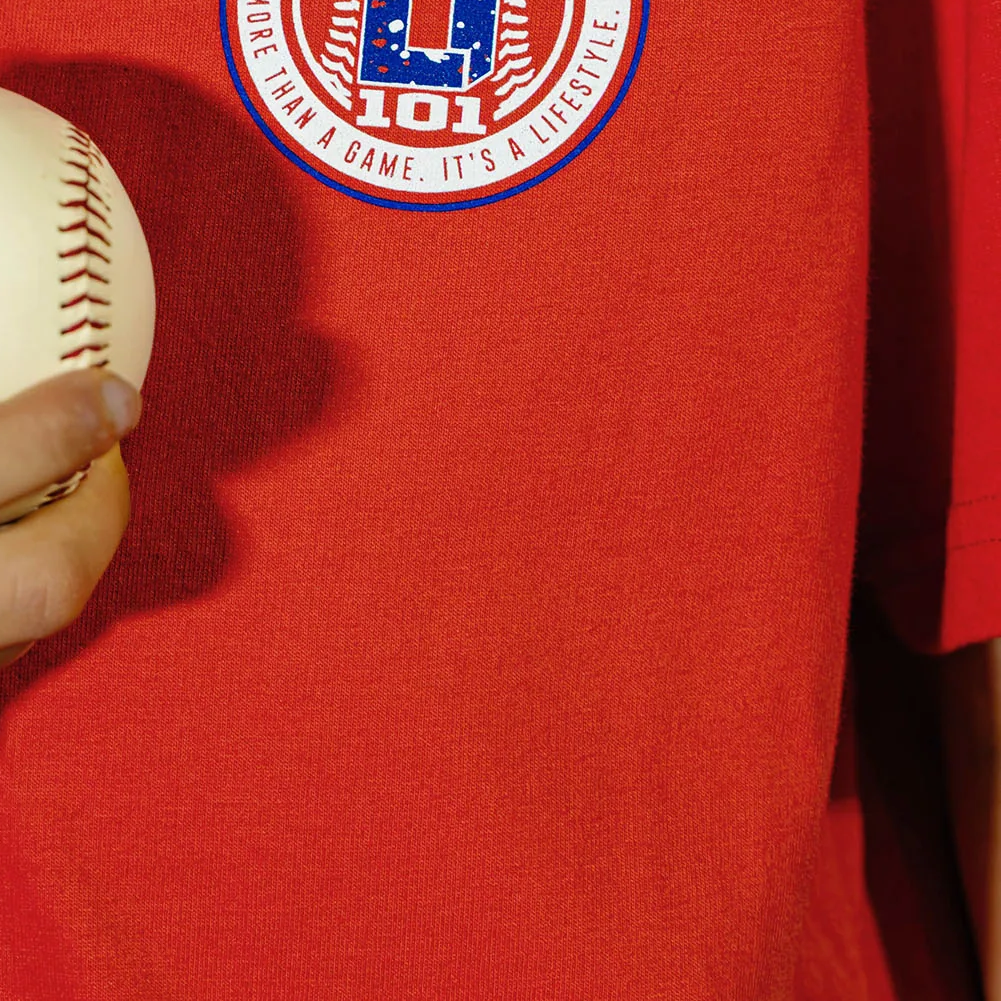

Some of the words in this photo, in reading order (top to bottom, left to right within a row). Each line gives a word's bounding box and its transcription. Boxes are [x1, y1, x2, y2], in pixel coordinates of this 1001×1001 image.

[267, 66, 318, 130] THAN
[317, 125, 337, 150] A
[343, 140, 425, 182] GAME.
[443, 149, 496, 182] IT'S
[509, 138, 526, 161] A
[526, 9, 621, 143] LIFESTYLE.
[356, 88, 487, 135] 101
